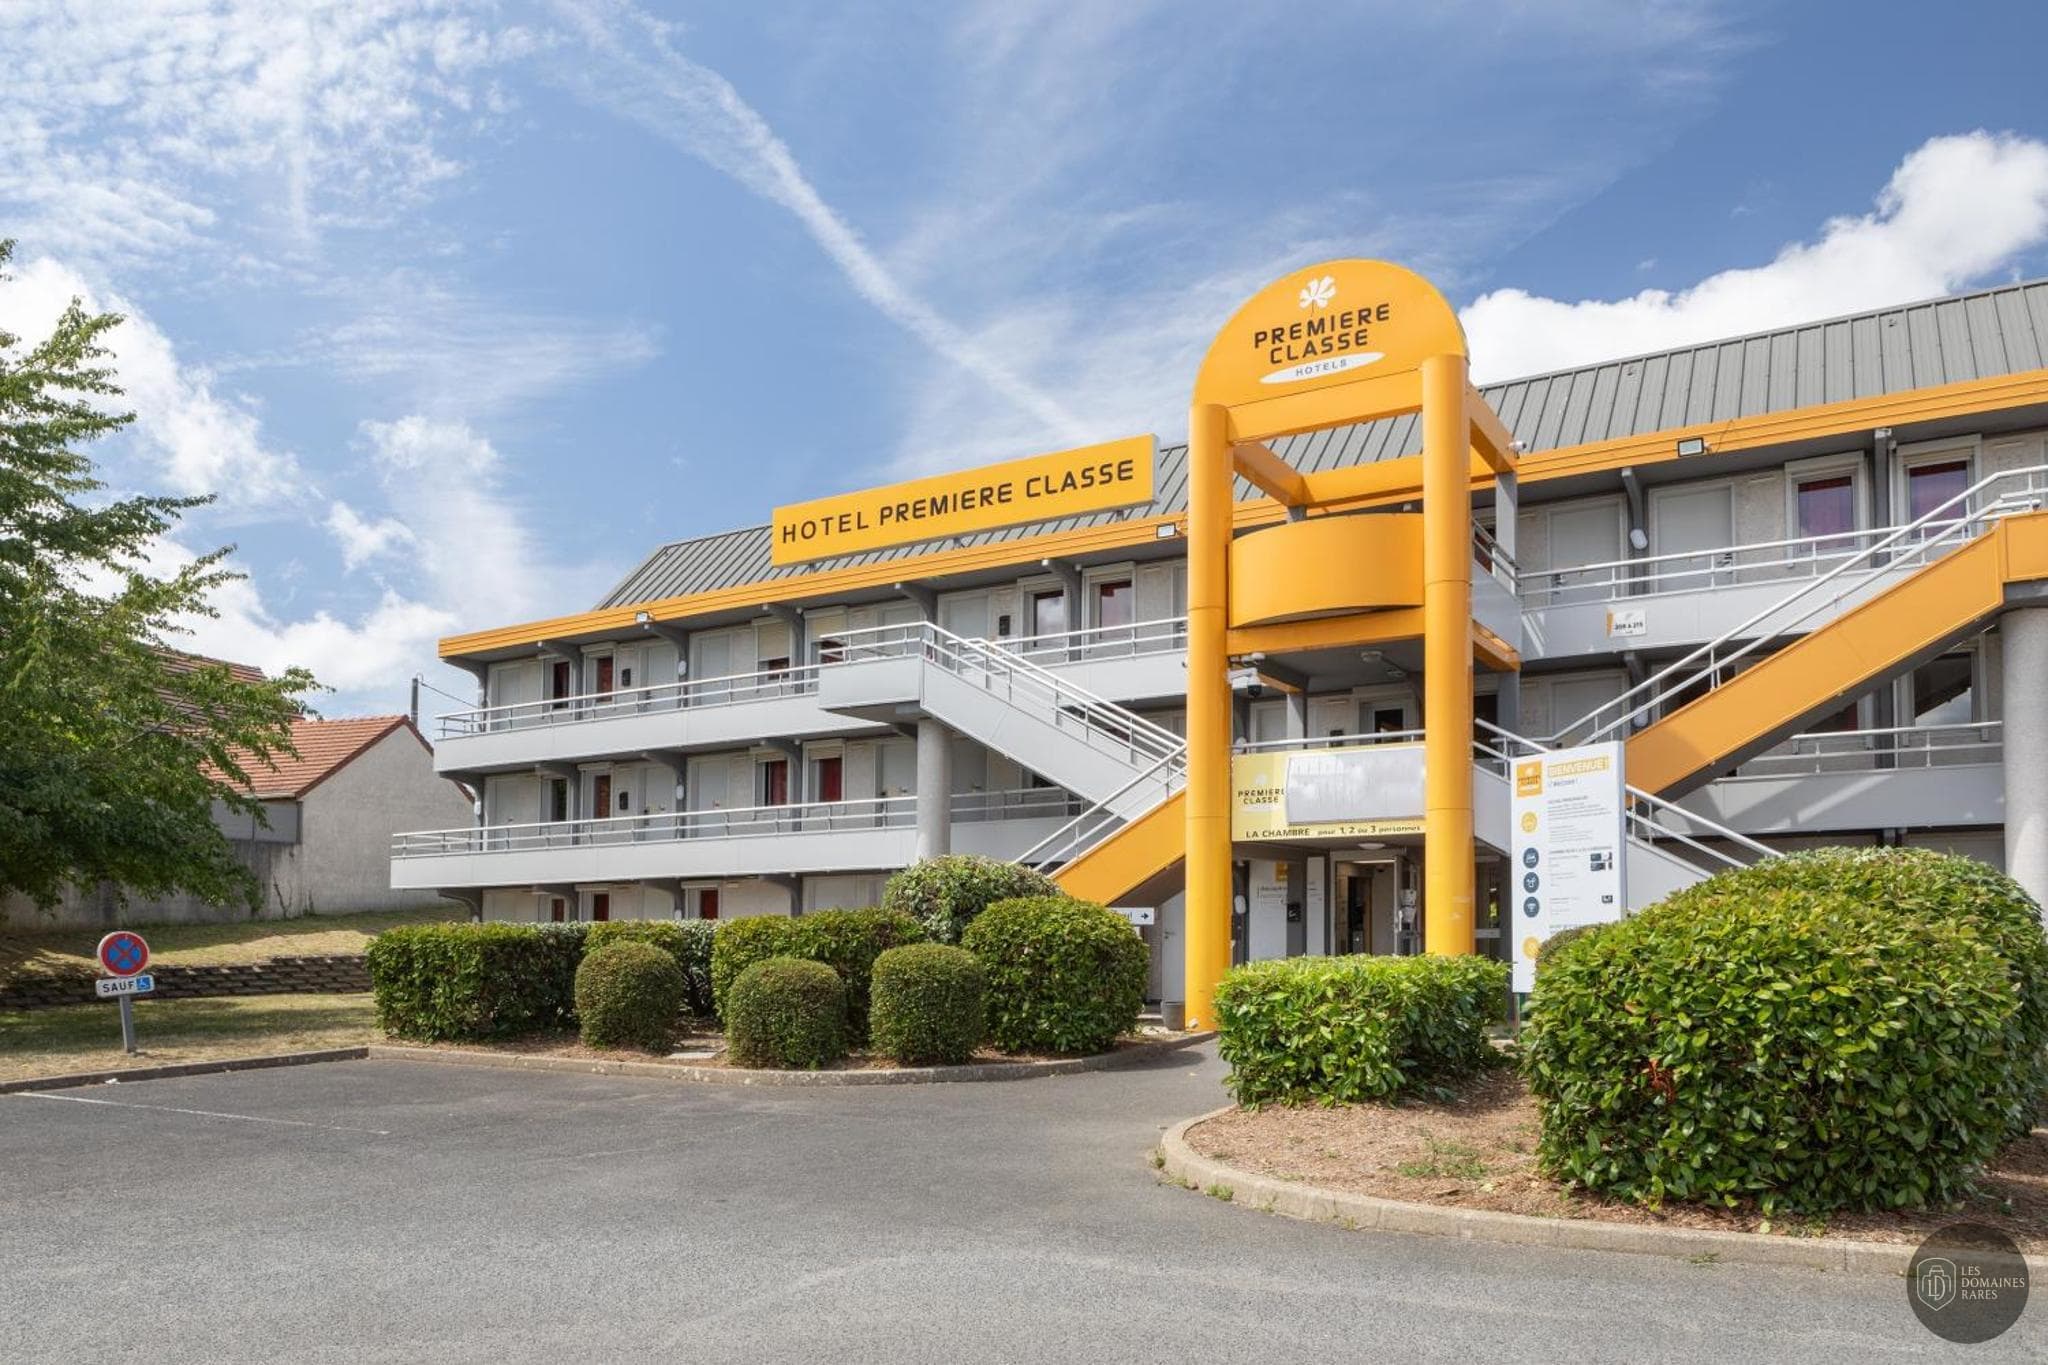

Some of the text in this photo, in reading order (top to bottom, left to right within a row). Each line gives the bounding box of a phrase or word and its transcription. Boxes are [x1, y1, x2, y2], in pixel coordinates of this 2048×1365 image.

[1254, 303, 1390, 349] PREMIERE
[1270, 328, 1368, 364] CLASSE
[1295, 359, 1348, 377] HOTELS
[782, 459, 1135, 544] HOTEL PREMIERE CLASSE
[1243, 796, 1279, 805] CLASSE
[1246, 830, 1259, 838] LA
[1262, 827, 1311, 838] CHAMBRE
[1349, 826, 1355, 834] 2
[1370, 825, 1376, 834] 3
[1379, 825, 1421, 834] personnes
[102, 980, 135, 993] SAUF
